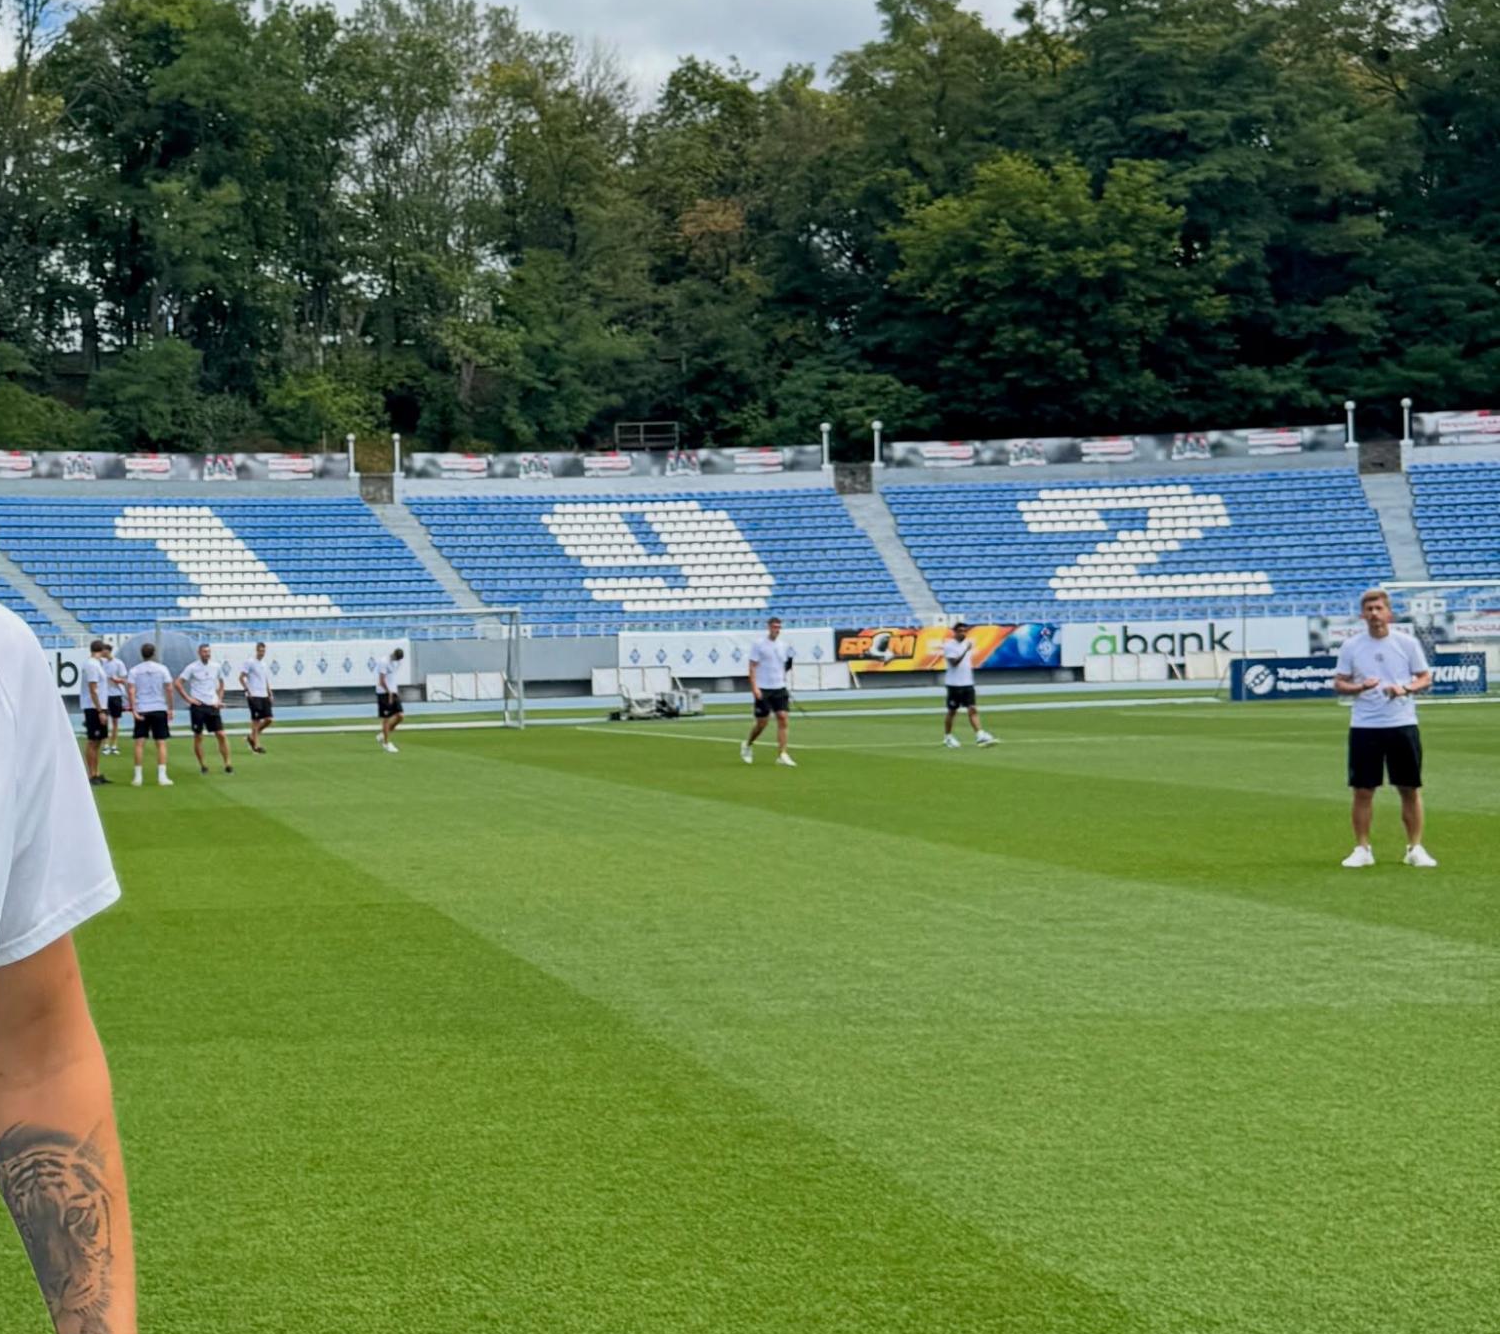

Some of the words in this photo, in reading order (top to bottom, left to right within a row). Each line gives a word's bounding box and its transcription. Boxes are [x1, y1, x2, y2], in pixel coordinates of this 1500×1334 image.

[114, 506, 342, 620] 1
[541, 500, 776, 612] 9
[1017, 484, 1273, 600] 2
